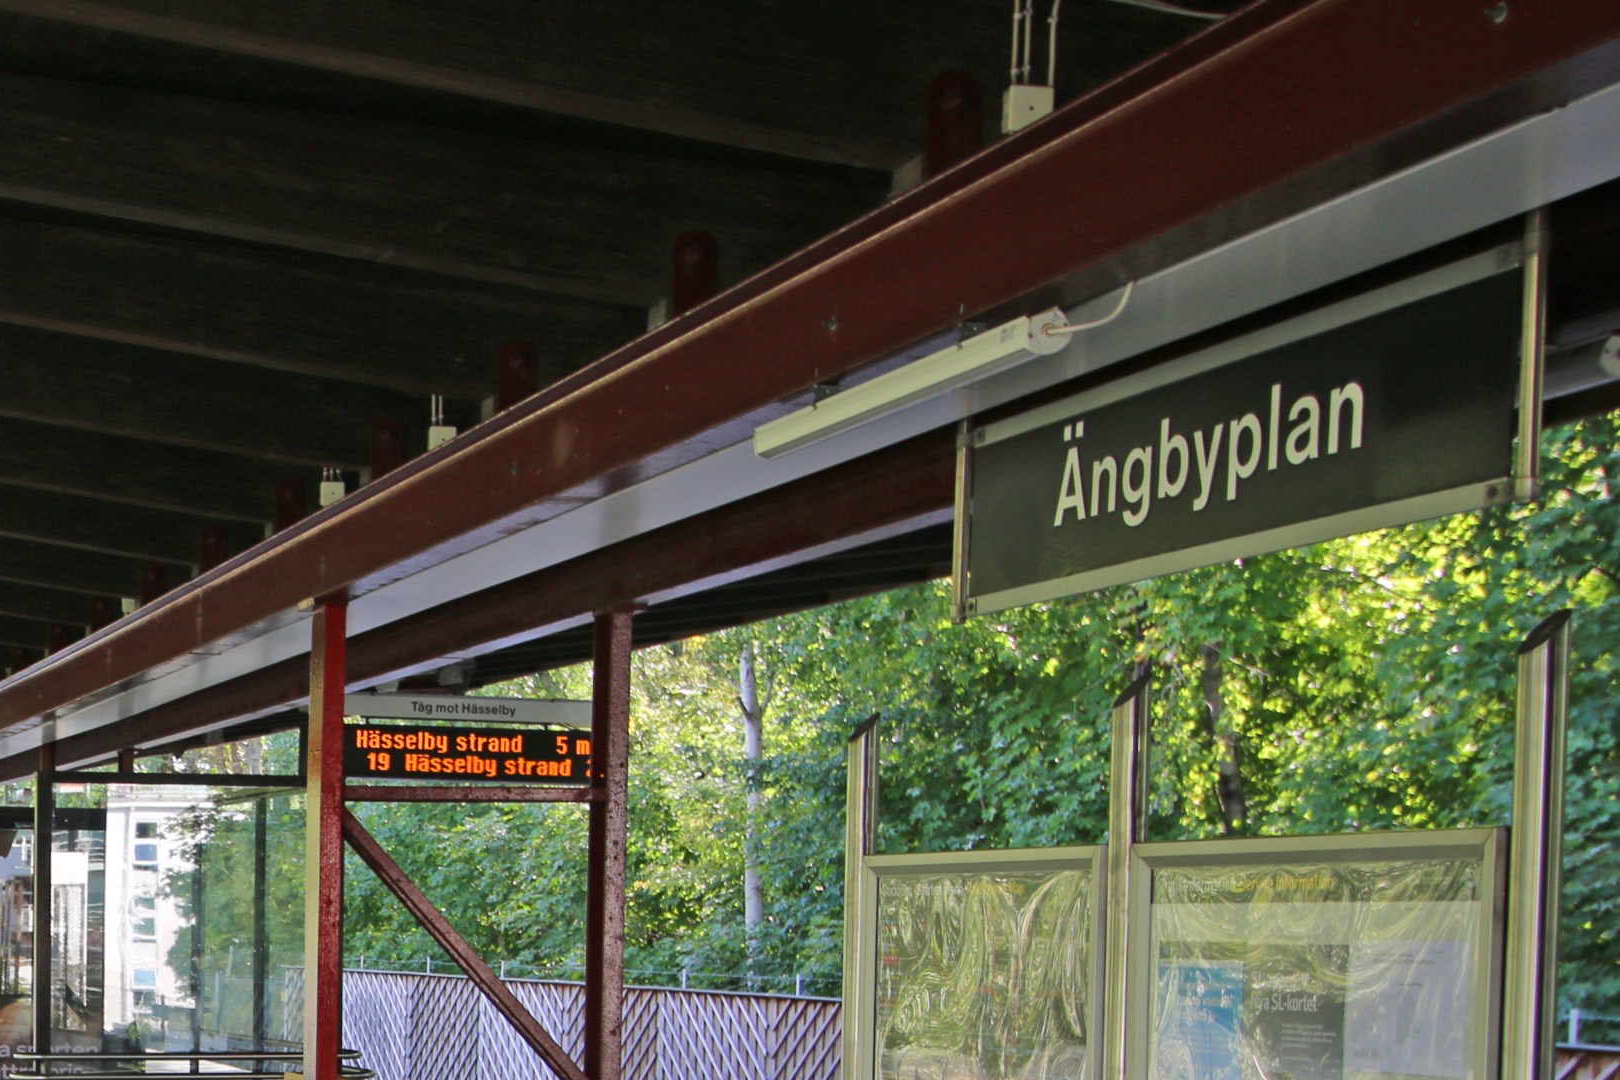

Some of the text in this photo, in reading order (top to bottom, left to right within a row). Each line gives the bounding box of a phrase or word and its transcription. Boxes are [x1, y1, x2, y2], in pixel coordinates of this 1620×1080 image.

[1053, 381, 1365, 528] Ängbyplan
[411, 701, 517, 718] Tåg mot Hässelby
[356, 729, 449, 754] Hässelby
[455, 733, 524, 753] strand
[555, 736, 569, 755] 5
[367, 752, 392, 771] 19
[404, 753, 498, 778] Hässelby
[504, 757, 573, 777] strand
[1271, 992, 1318, 1012] SL-kortet
